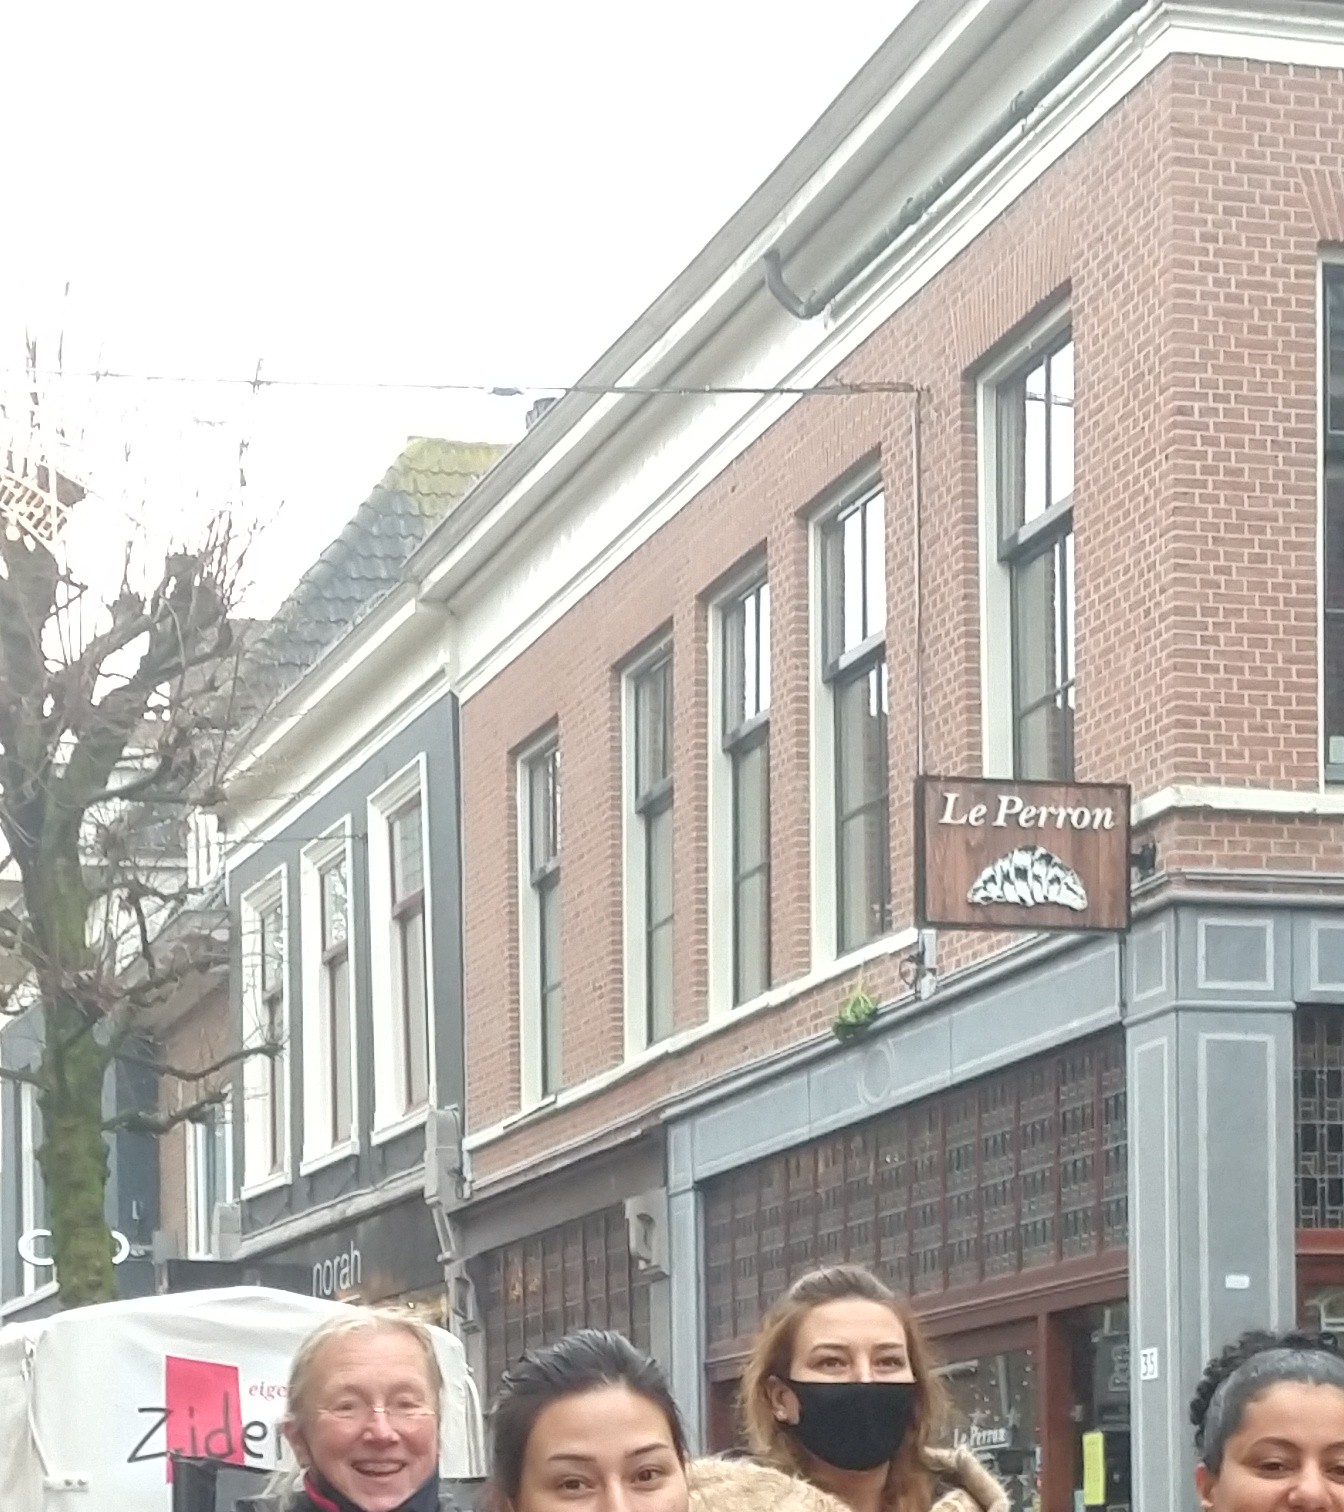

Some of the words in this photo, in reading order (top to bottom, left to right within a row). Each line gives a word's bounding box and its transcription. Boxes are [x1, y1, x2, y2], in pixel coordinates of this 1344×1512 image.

[939, 792, 988, 827] Le
[992, 794, 1115, 830] Perron
[312, 1240, 362, 1297] norah
[1140, 1352, 1156, 1378] 35
